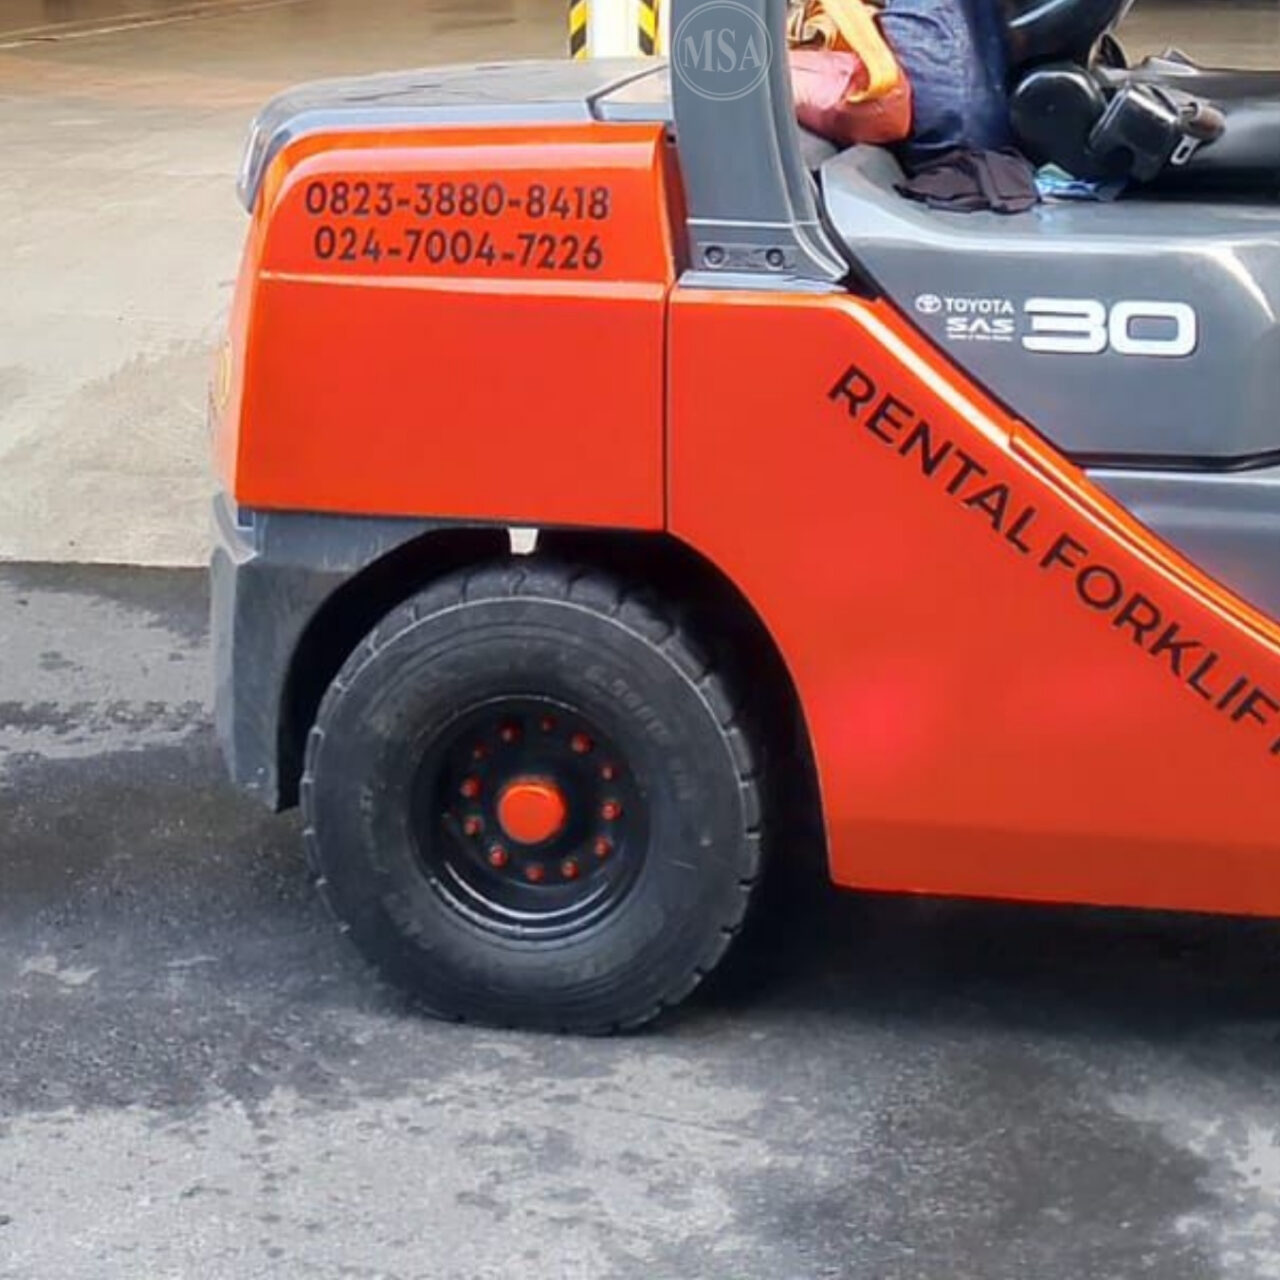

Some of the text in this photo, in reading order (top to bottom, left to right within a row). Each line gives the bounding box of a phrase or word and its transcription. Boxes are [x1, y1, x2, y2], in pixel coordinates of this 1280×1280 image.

[304, 180, 609, 221] 0823-3880-8418
[313, 225, 603, 271] 024-7004-7226
[944, 297, 1015, 314] TOYOTA
[945, 317, 1015, 333] SAS
[1021, 297, 1197, 357] 30
[826, 364, 1037, 555] RENTAL
